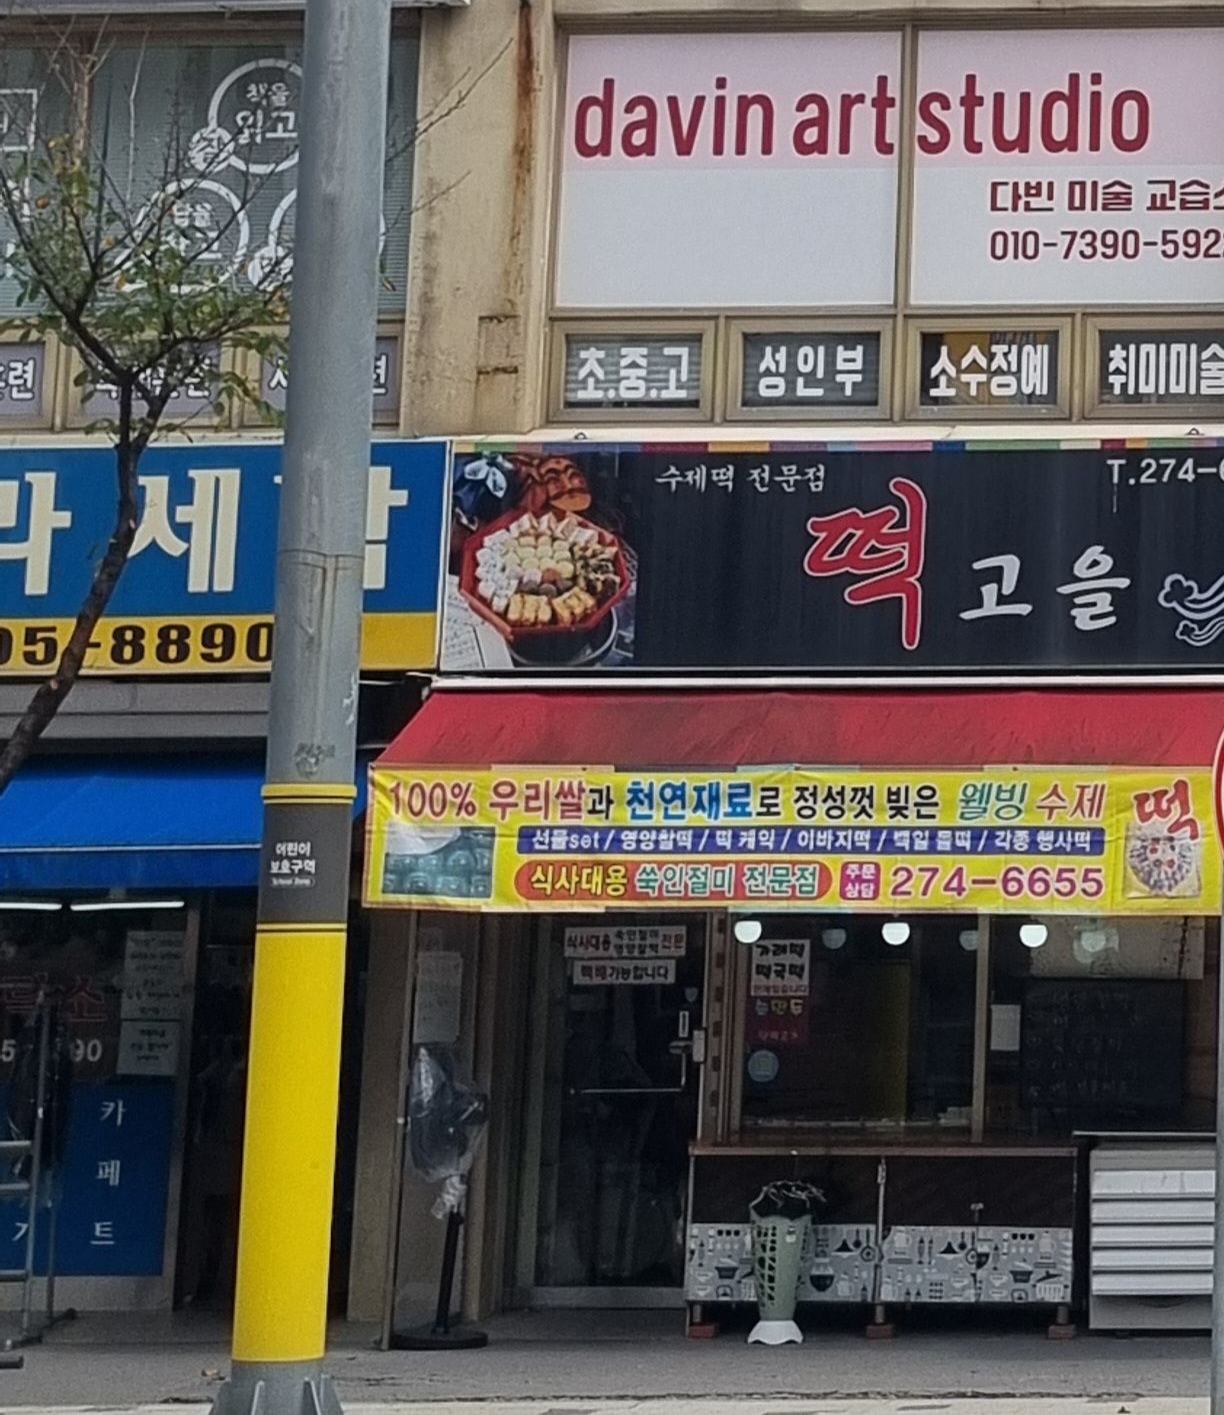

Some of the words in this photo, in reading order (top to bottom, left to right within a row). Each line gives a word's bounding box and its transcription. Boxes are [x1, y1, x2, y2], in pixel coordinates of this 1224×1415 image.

[574, 78, 775, 158] davin
[793, 75, 896, 156] art
[917, 72, 1151, 154] studio
[990, 180, 1055, 213] 다빈
[1067, 180, 1133, 212] 미술
[575, 345, 690, 401] 초.중.고
[758, 344, 864, 398] 성인부
[930, 343, 1049, 397] 소수정예
[655, 465, 735, 492] 수제떡
[748, 462, 828, 492] 전문점
[390, 781, 477, 819] 100%
[489, 779, 615, 820] 우리쌀과
[626, 780, 782, 821] 천연재료로
[792, 784, 875, 820] 정성껏
[886, 783, 940, 820] 빚은
[957, 781, 1028, 821] 웰빙
[1035, 782, 1106, 821] 수제
[1133, 779, 1200, 841] 떡
[275, 841, 311, 857] 어린이
[797, 828, 870, 851] 이바지떡
[270, 859, 316, 874] 보호구역
[532, 862, 627, 896] 식사대용
[635, 865, 733, 896] 쑥인절미
[742, 865, 818, 896] 전문점
[890, 866, 1104, 898] 274-6655
